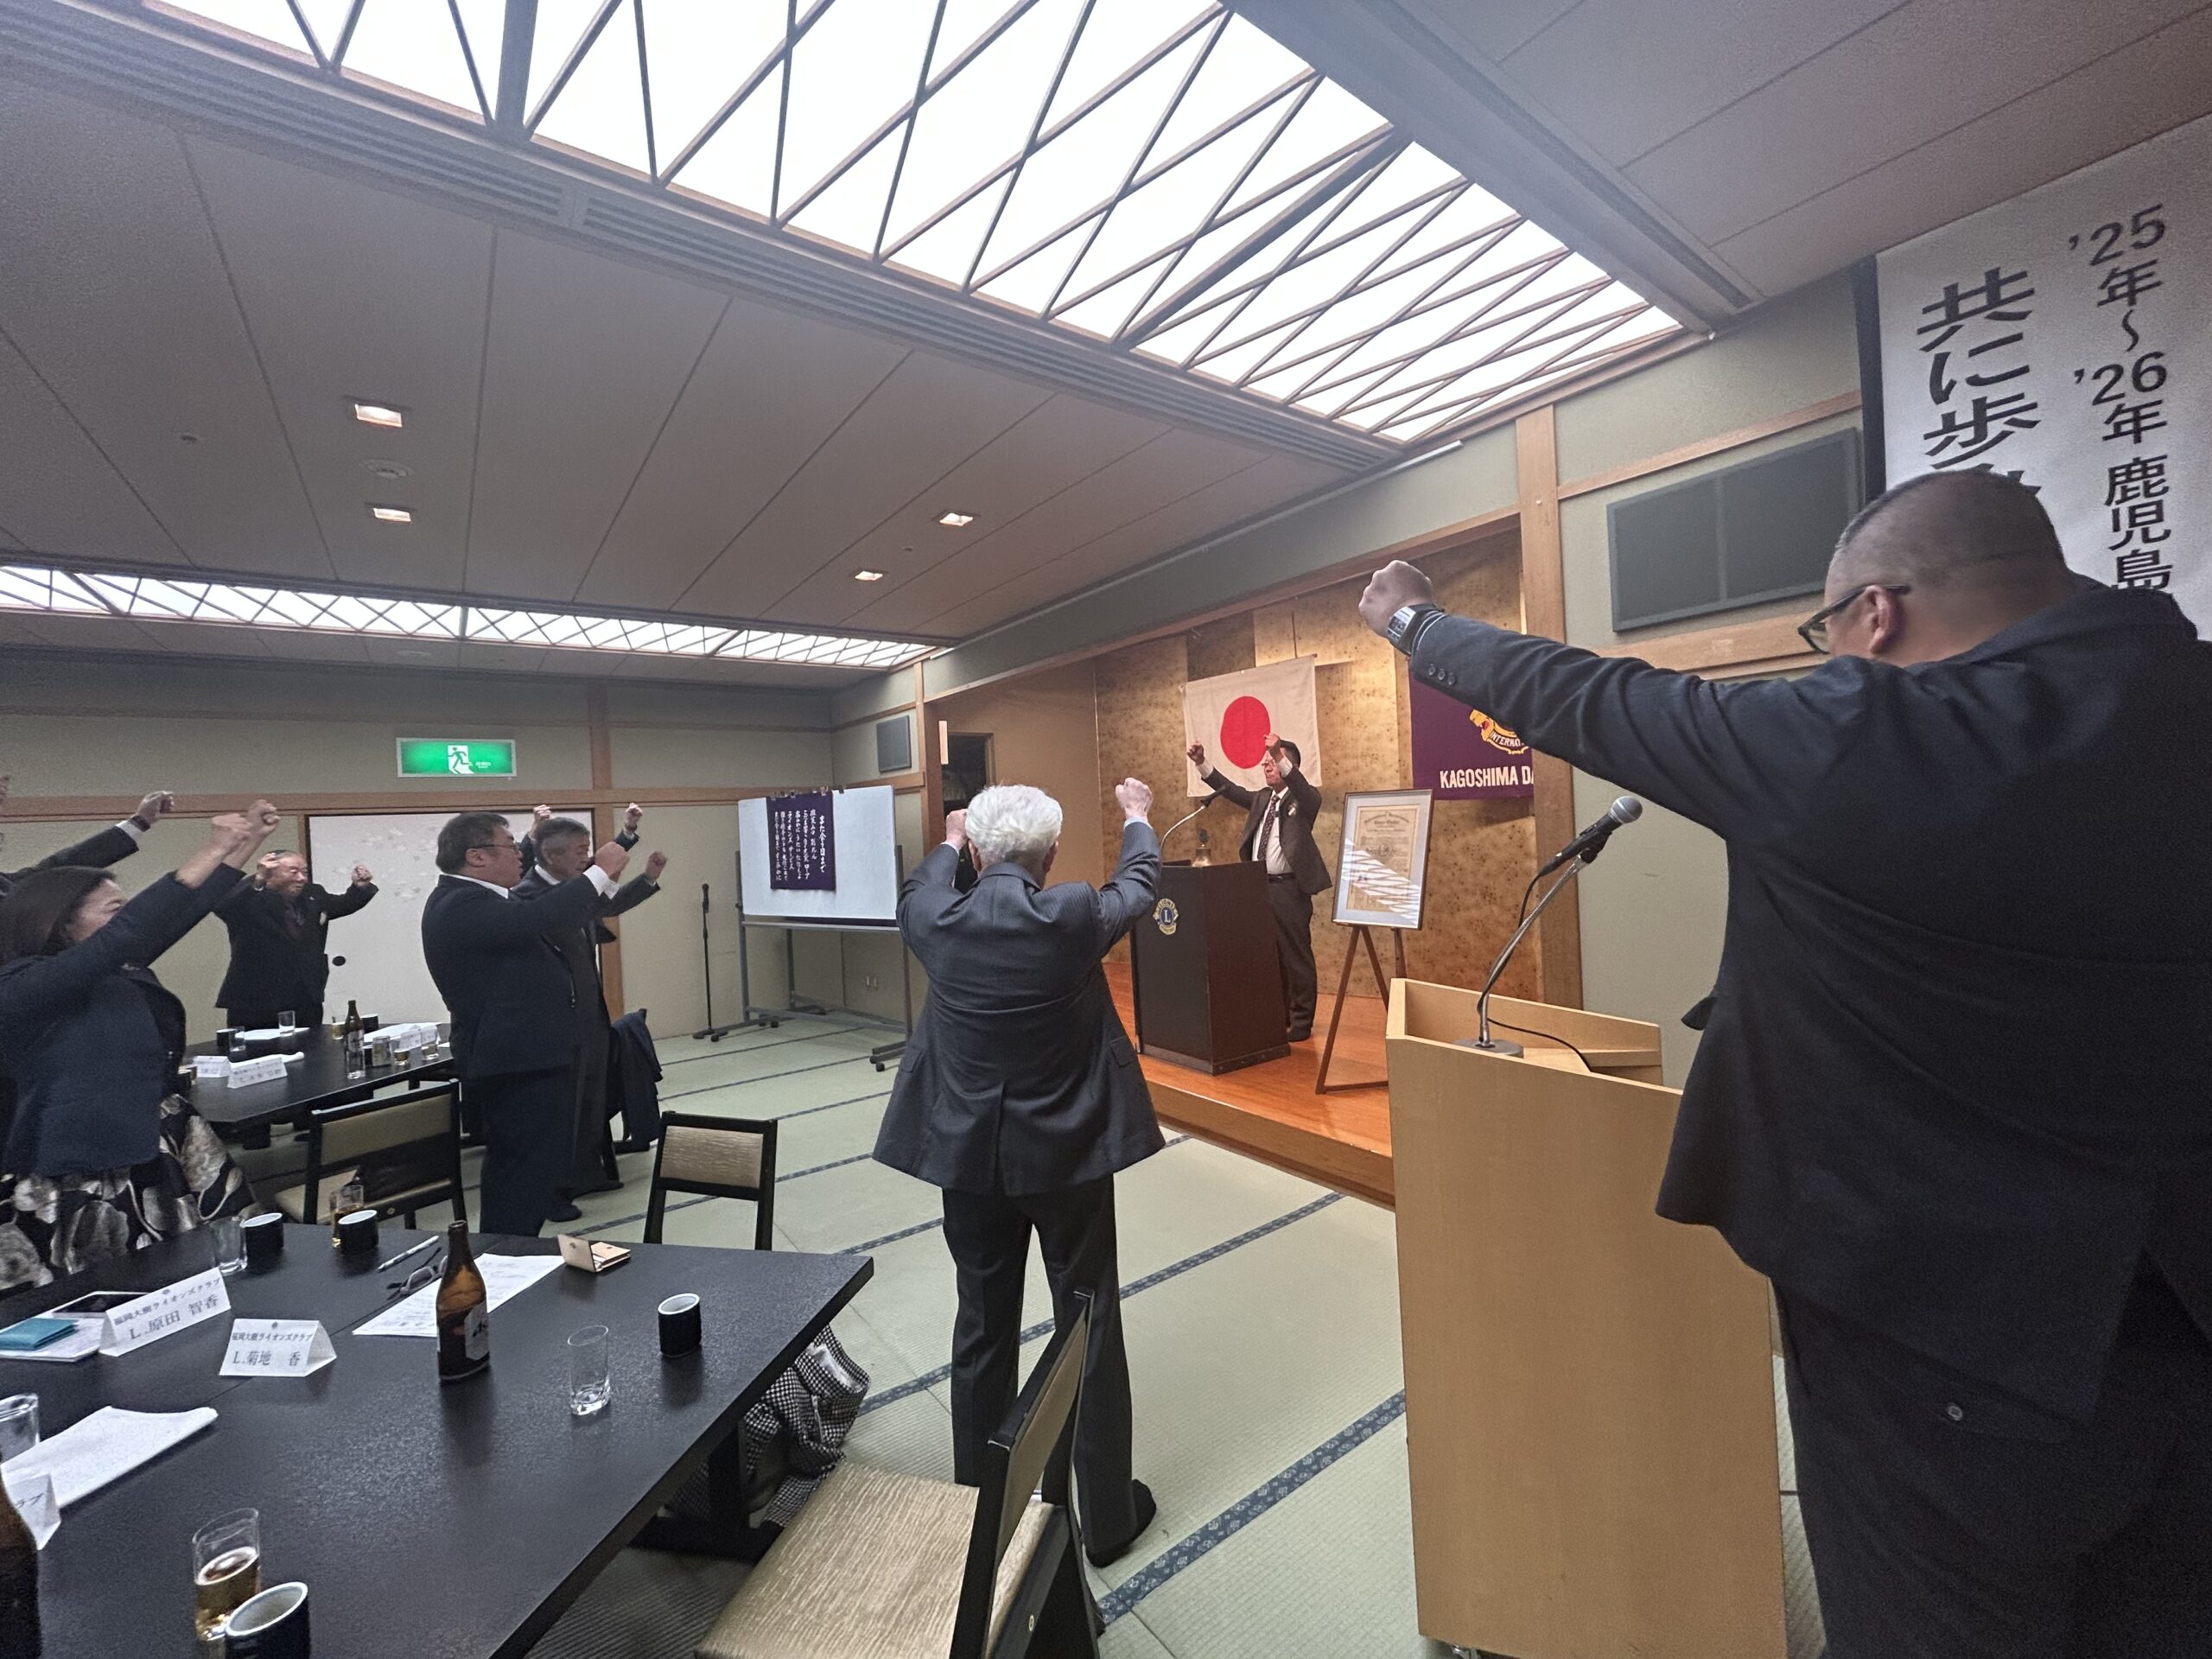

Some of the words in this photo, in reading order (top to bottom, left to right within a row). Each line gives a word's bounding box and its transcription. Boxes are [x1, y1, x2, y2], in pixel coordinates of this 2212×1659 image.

[1916, 266, 2042, 496] 共に歩
[1489, 730, 1525, 747] INTERNAT
[1440, 766, 1518, 788] KAGOSHIMA
[1164, 909, 1171, 923] L
